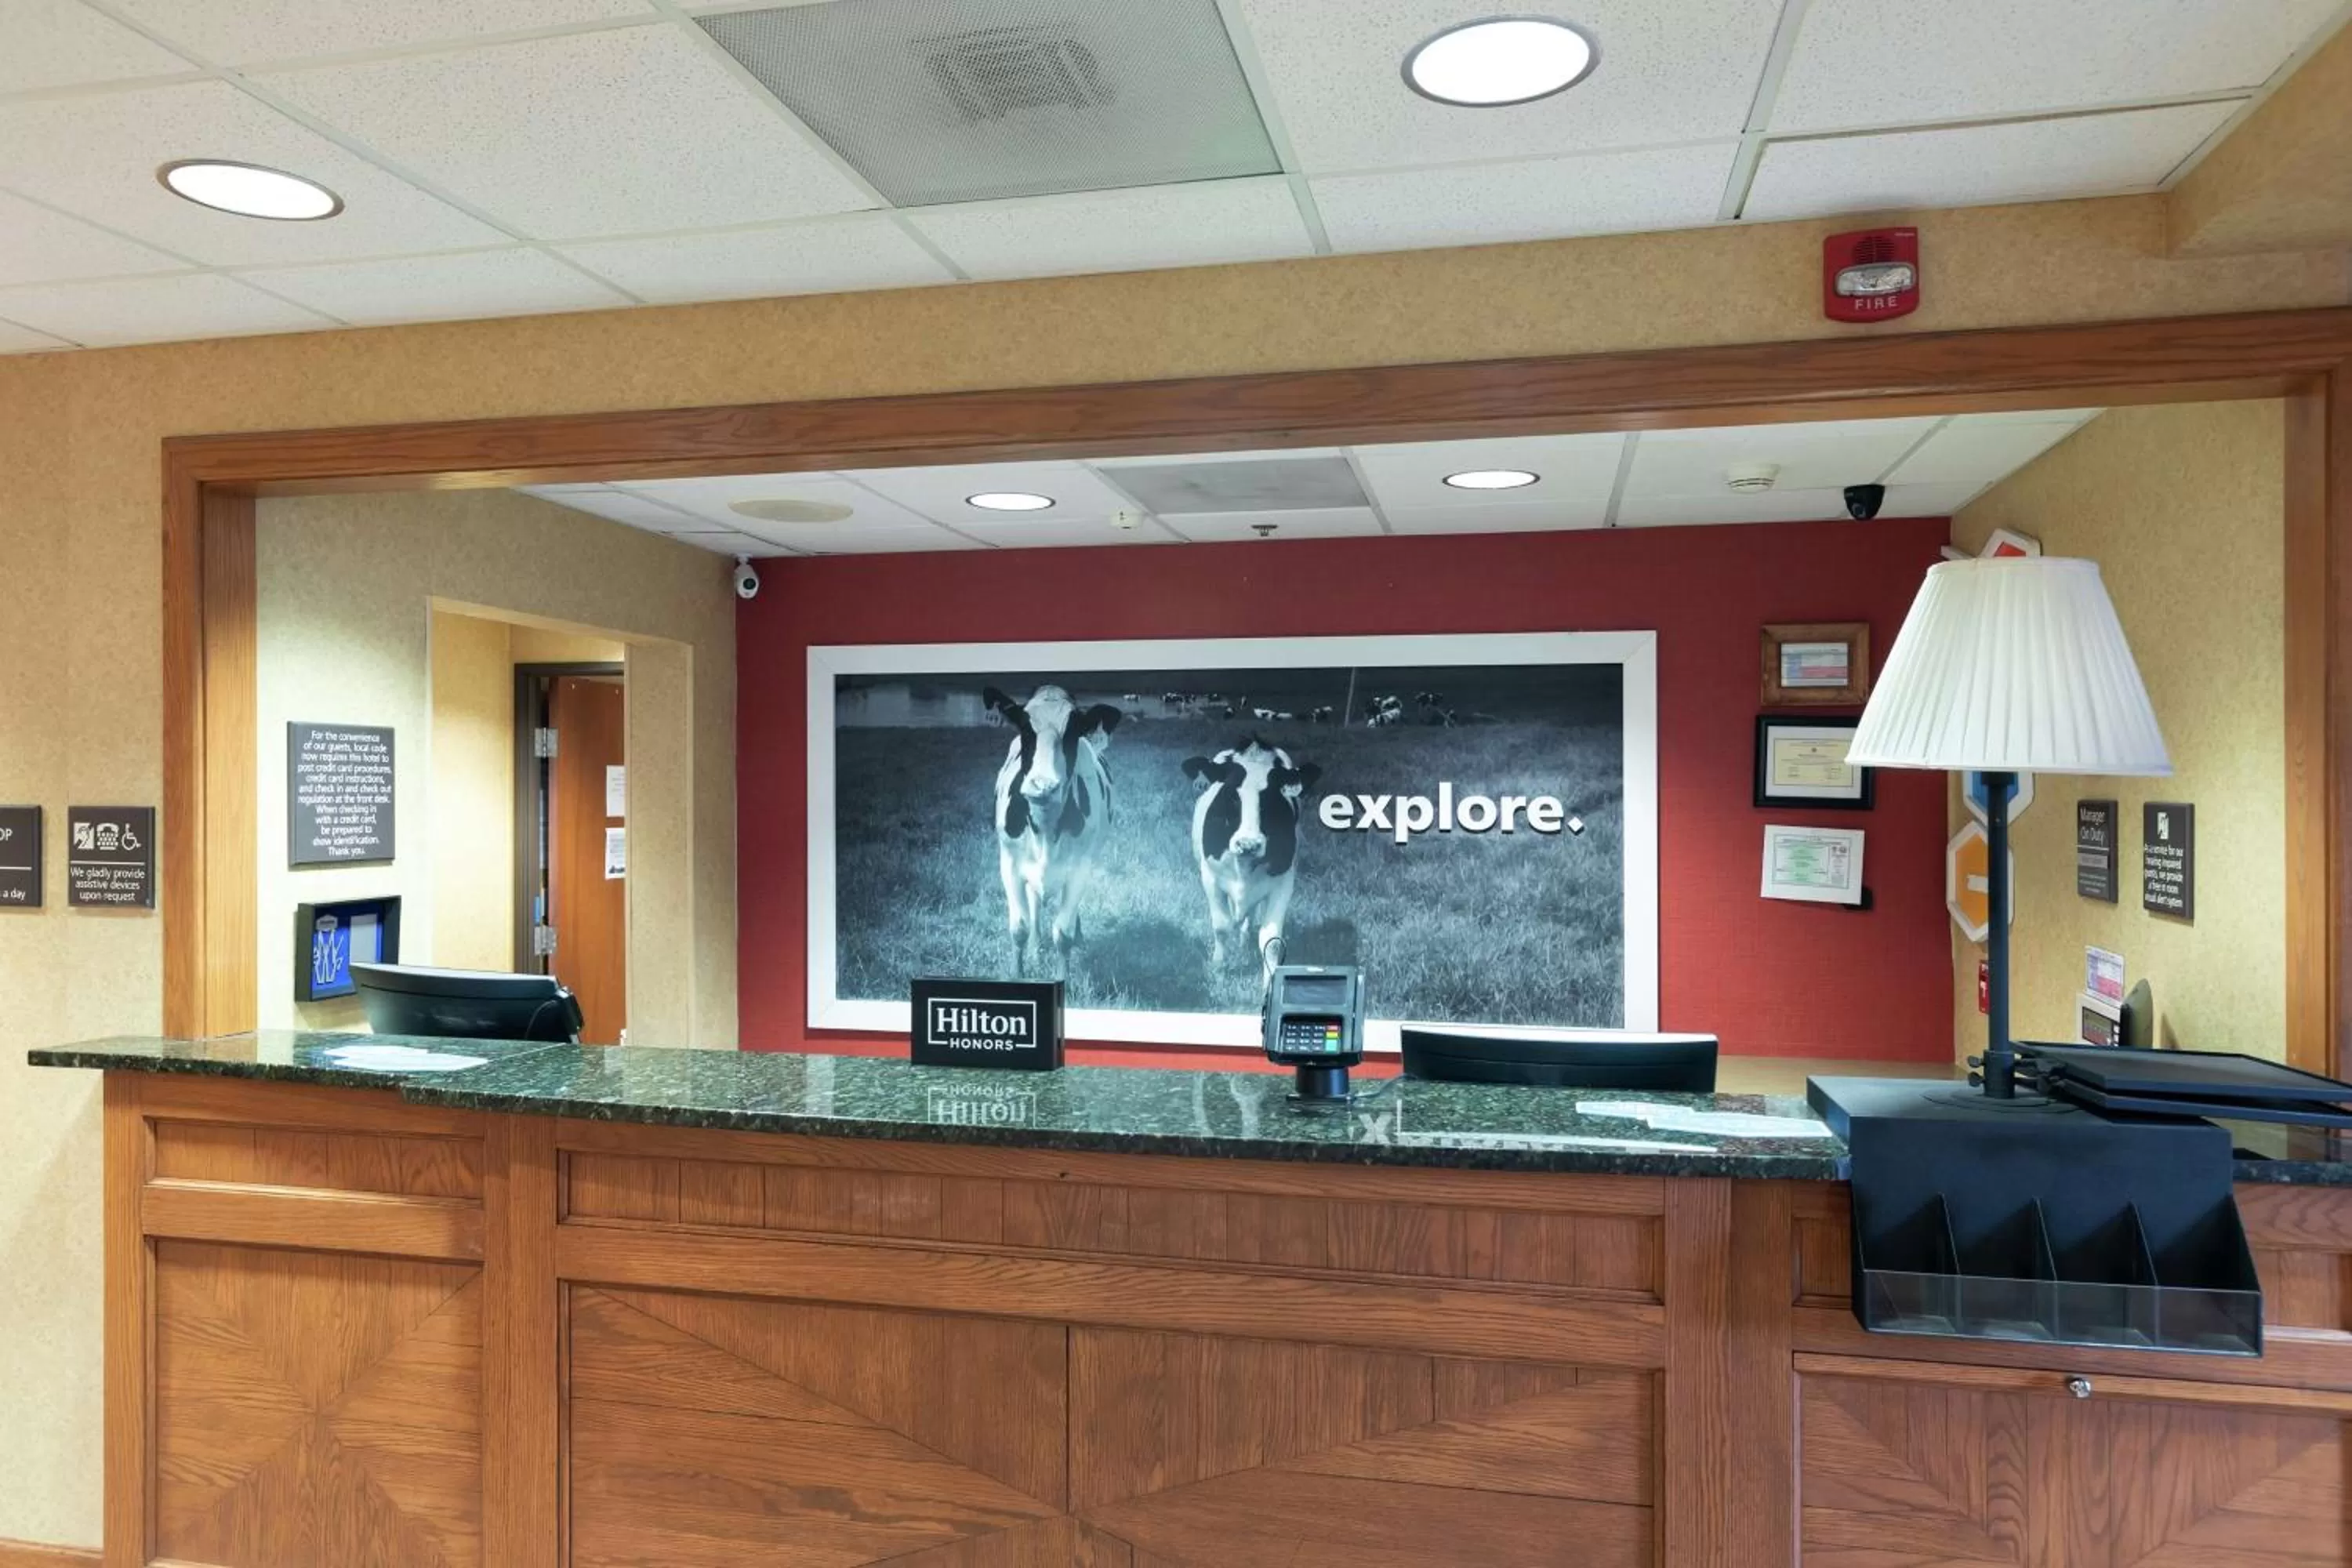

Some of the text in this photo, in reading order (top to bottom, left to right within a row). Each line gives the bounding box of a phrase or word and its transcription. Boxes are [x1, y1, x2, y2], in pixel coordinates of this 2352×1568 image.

[1855, 296, 1897, 310] FIRE
[311, 731, 380, 742] For the convenience
[303, 740, 313, 750] of
[371, 744, 387, 753] code
[319, 753, 347, 764] requires
[350, 753, 361, 762] this
[363, 753, 380, 762] hotel
[297, 764, 314, 773] post
[315, 762, 336, 772] credit
[337, 764, 352, 772] card
[305, 773, 326, 782] credit
[328, 774, 343, 782] card
[299, 784, 313, 793] and
[314, 784, 335, 793] check
[337, 784, 343, 793] in
[345, 784, 358, 793] and
[360, 784, 378, 793] check
[344, 794, 354, 803] the
[357, 794, 373, 803] front
[315, 804, 377, 815] When checking in
[315, 815, 332, 824] with
[339, 815, 360, 823] credit
[2080, 807, 2106, 825] Manager
[321, 825, 372, 837] be prepared to
[2091, 827, 2105, 845] Duty
[313, 837, 332, 846] show
[328, 847, 350, 856] Thank
[71, 867, 145, 880] We gladly provide
[75, 880, 140, 890] assistive devices
[10, 887, 26, 900] day
[79, 892, 136, 902] upon request
[936, 1007, 1027, 1036] Hilton
[950, 1038, 1013, 1051] HONORS
